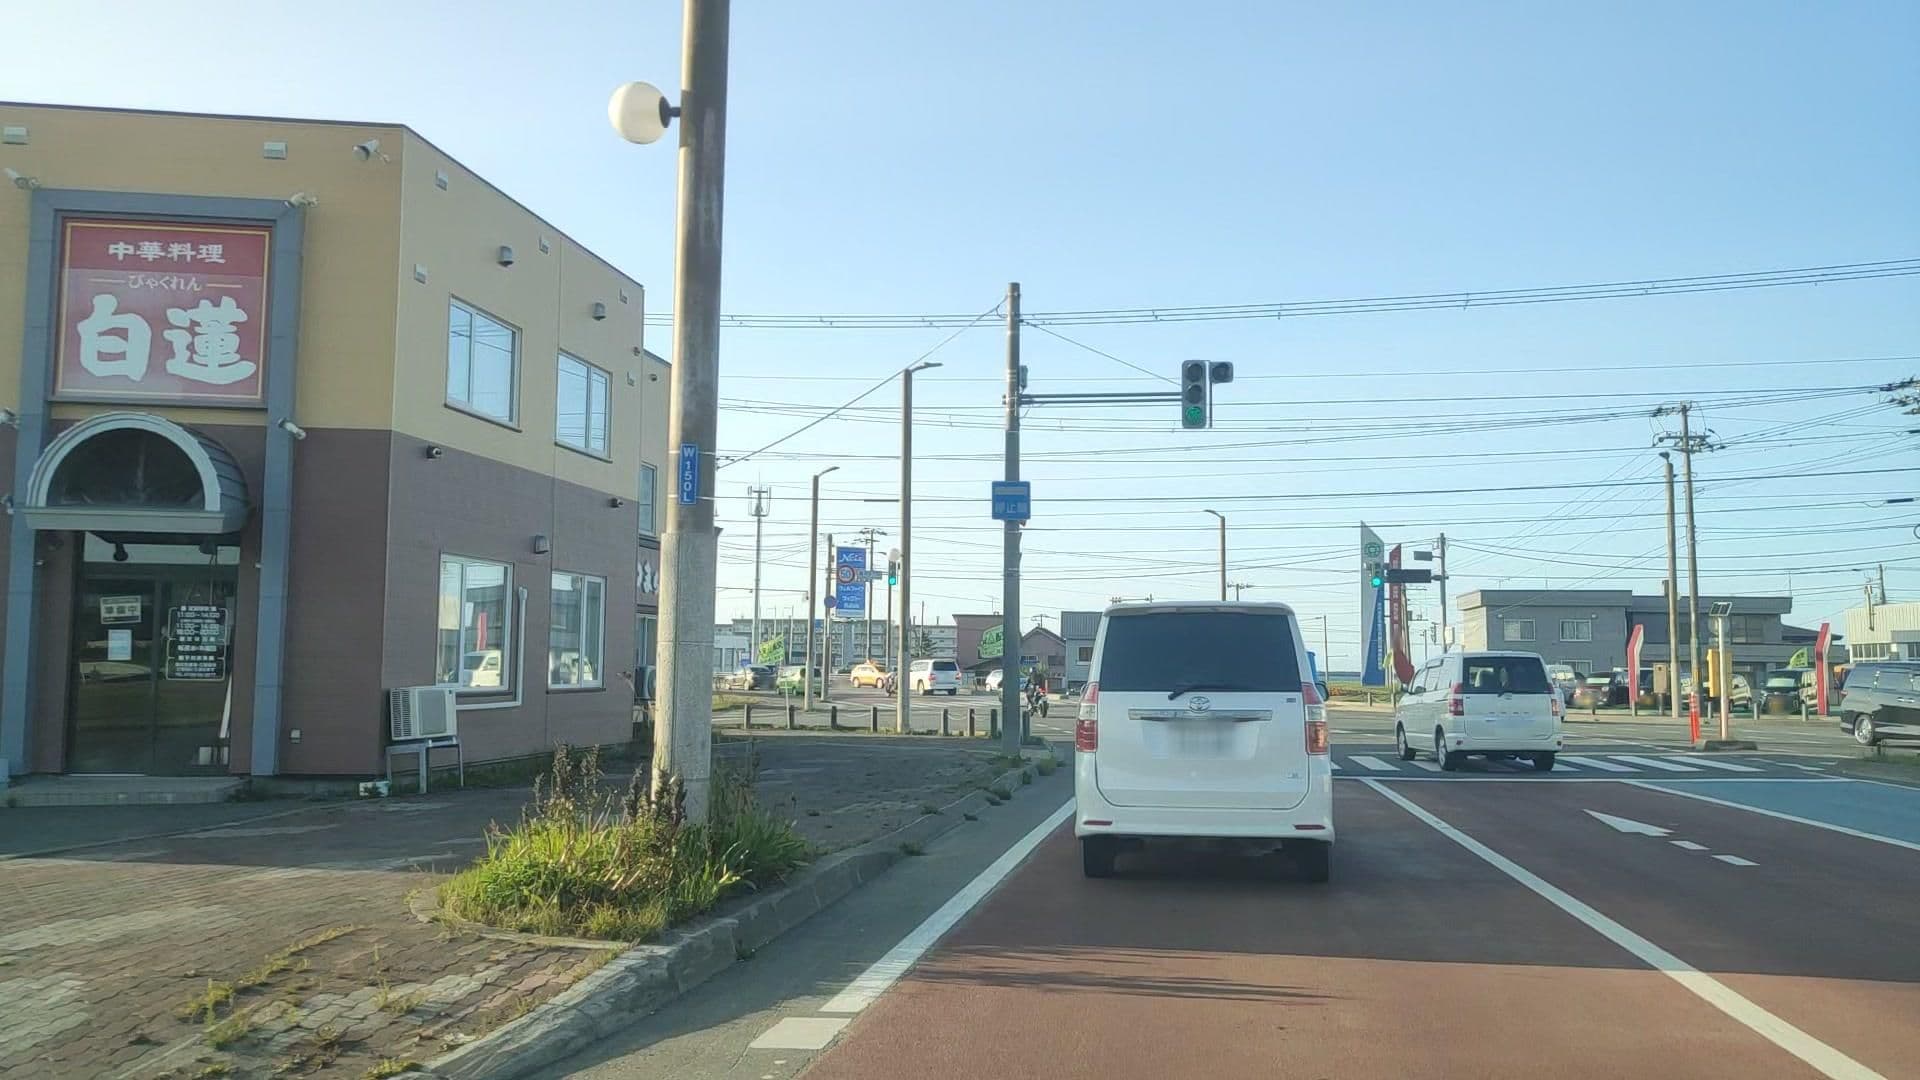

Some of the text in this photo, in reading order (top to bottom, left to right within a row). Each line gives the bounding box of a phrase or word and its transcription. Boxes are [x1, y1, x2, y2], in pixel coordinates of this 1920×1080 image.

[107, 241, 226, 264] 中華料理
[128, 275, 202, 291] びゃくれん
[77, 294, 257, 385] 白蓮
[682, 447, 696, 502] W150L
